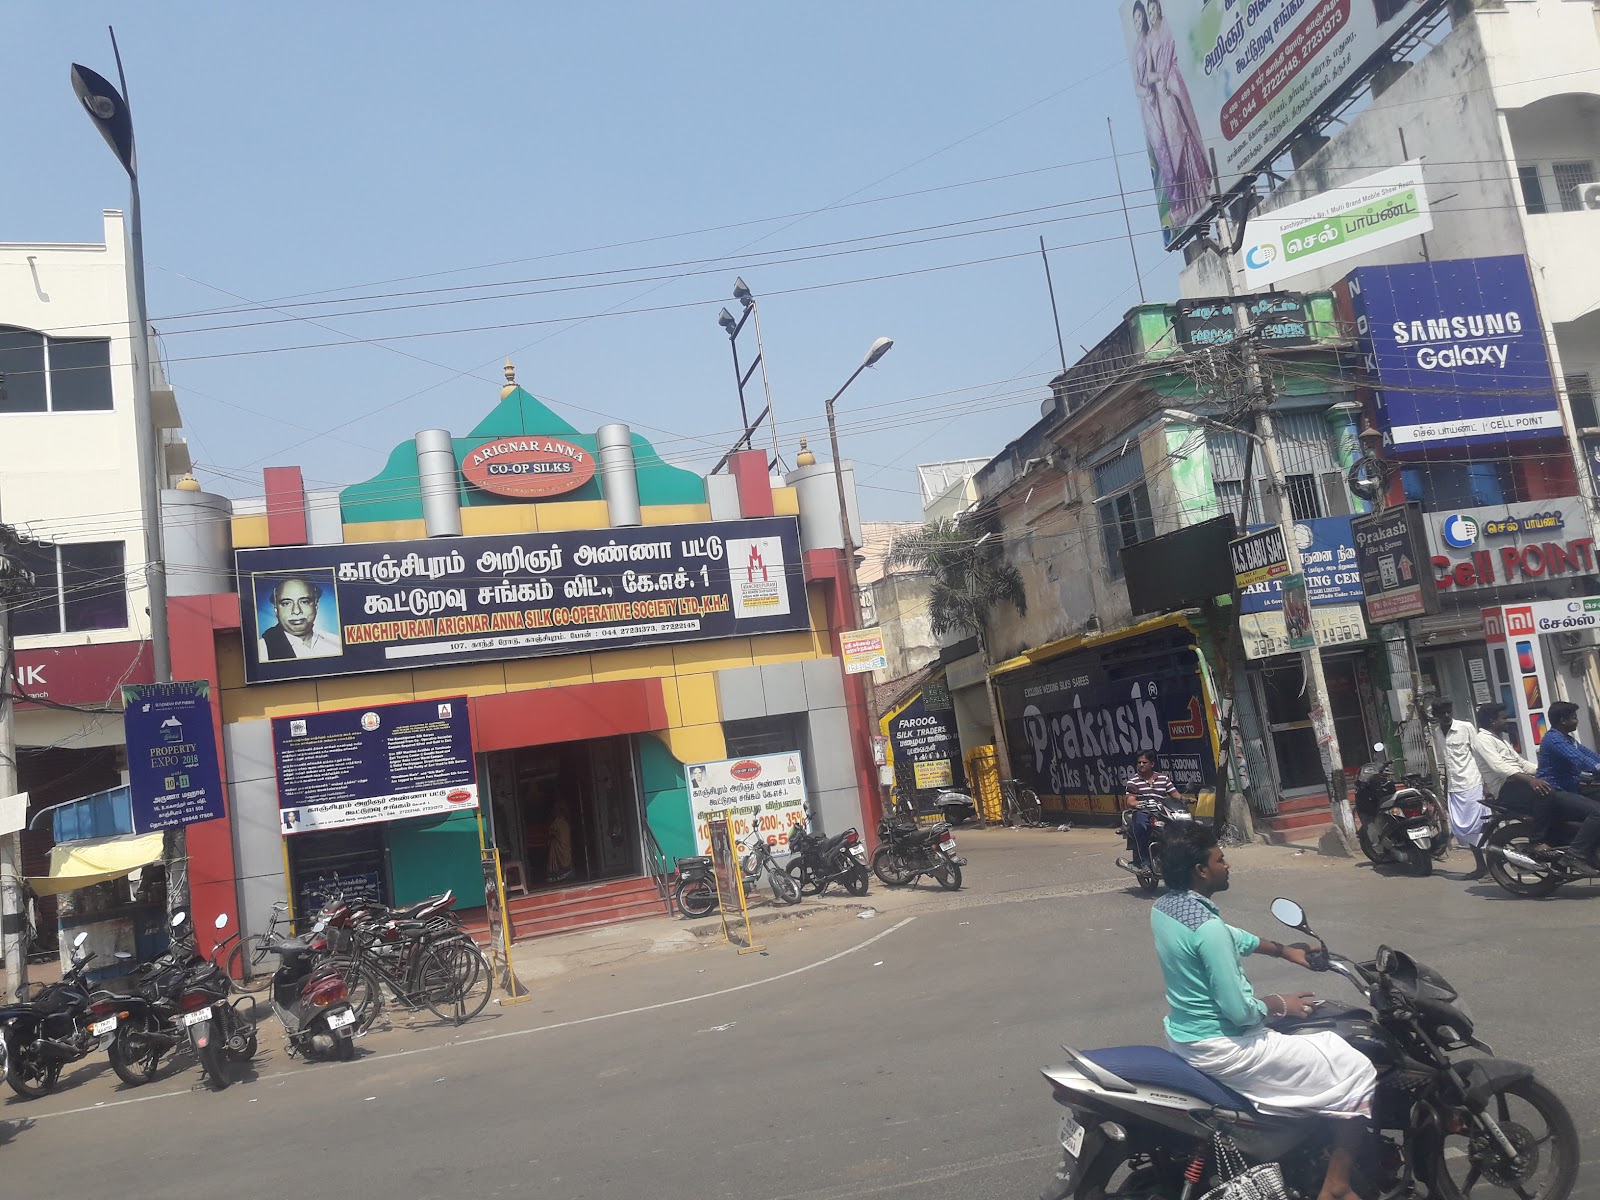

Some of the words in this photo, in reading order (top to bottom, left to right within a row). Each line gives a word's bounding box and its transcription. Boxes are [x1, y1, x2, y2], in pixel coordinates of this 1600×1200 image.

[1242, 98, 1257, 118] 044
[1302, 9, 1343, 59] 27231373
[1330, 202, 1345, 214] Multi
[1346, 197, 1362, 209] Brand
[1362, 191, 1380, 204] Mobile
[1381, 187, 1397, 197] Show
[1398, 179, 1415, 191] Room
[1286, 224, 1338, 254] செல்
[1393, 311, 1522, 344] SAMSUNG
[1417, 344, 1508, 370] Galaxy
[1490, 419, 1514, 430] CELL
[1516, 416, 1543, 428] POINT
[472, 441, 540, 466] ARIGNAR
[543, 442, 584, 464] ANNA
[489, 463, 530, 475] CO-OP
[533, 462, 571, 474] SILKS
[1356, 520, 1407, 548] Prakash
[1487, 519, 1519, 534] செல்
[338, 549, 466, 585] காஞ்சிபுரம்
[476, 543, 563, 577] அறிஞர்
[573, 540, 672, 566] அண்ணா
[681, 536, 724, 560] பட்டு
[1232, 545, 1248, 574] A.S.
[1245, 538, 1268, 570] BABU
[1265, 532, 1285, 564] SAH
[1501, 537, 1594, 582] POINT
[1241, 581, 1271, 594] ARI
[1335, 572, 1360, 585] CEN
[364, 588, 468, 616] கூட்டுறவு
[478, 578, 554, 605] சங்கம்
[345, 618, 434, 644] KANCHIPURAM
[438, 614, 490, 636] ARIGNAR
[492, 611, 525, 631] ANNA
[525, 608, 551, 628] SILK
[554, 601, 631, 625] CO-OPERATIVE
[632, 599, 677, 619] SOCIETY
[1539, 613, 1595, 630] சேல்ஸ்
[1072, 675, 1089, 687] SAREES
[896, 730, 913, 739] SILK
[917, 726, 947, 736] TRADERS
[899, 716, 938, 729] FAROOQ
[1023, 682, 1163, 773] Prakash
[1171, 725, 1185, 734] WAY
[1186, 725, 1195, 733] TO
[150, 743, 196, 757] PROPERTY
[150, 756, 178, 768] EXPO
[182, 755, 199, 765] 2018
[166, 779, 174, 788] 10
[181, 777, 188, 787] 11
[693, 784, 728, 798] காஞ்சிபுரம்
[730, 781, 755, 793] அறிஞர்
[739, 790, 761, 801] சங்கம்
